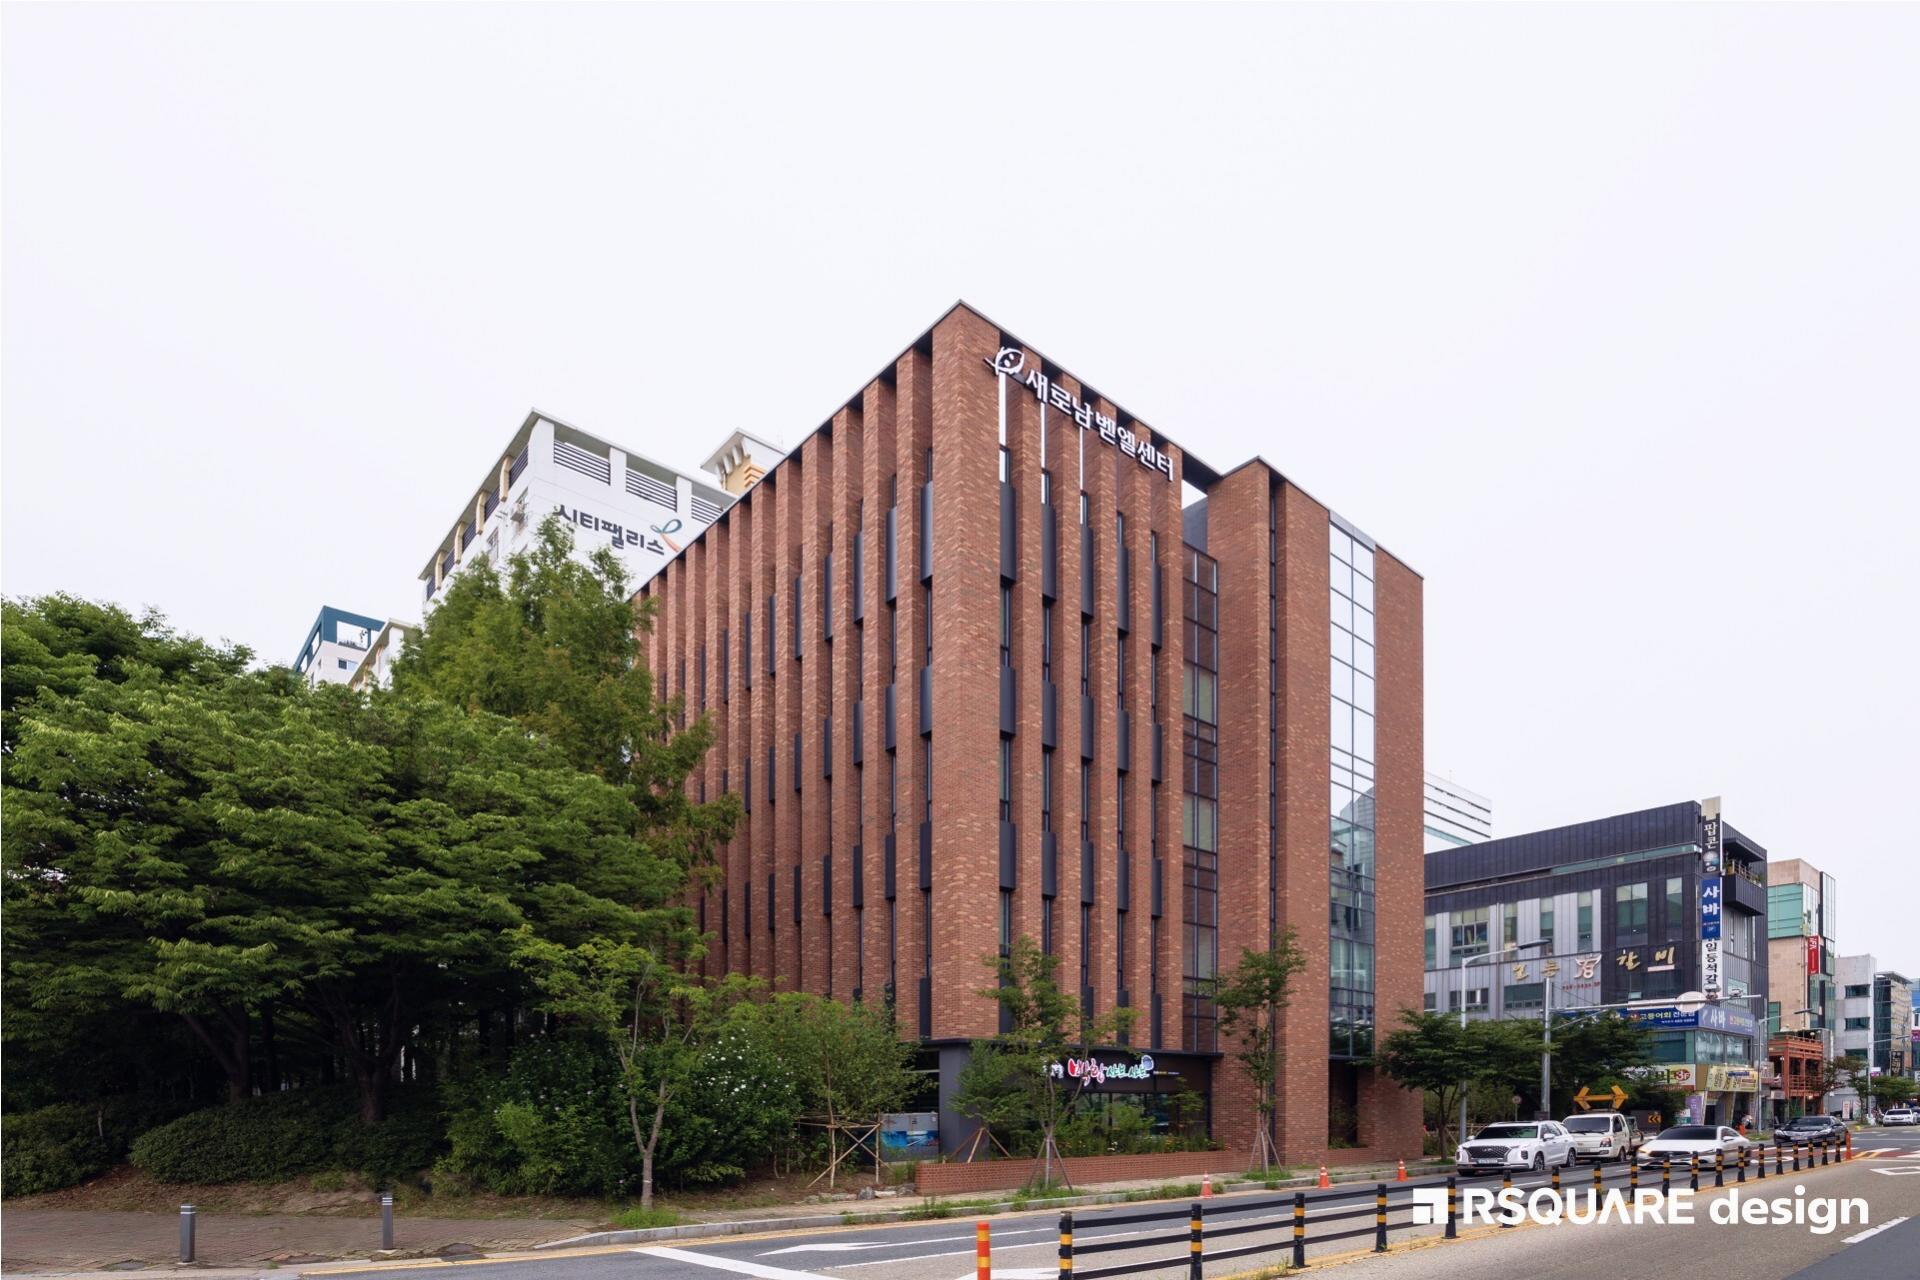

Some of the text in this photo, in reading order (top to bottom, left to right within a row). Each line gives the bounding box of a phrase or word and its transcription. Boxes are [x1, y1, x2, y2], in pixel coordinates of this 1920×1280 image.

[552, 504, 665, 556] 시티팰리스
[1702, 885, 1720, 916] 사바
[1705, 941, 1718, 991] 일등석갈
